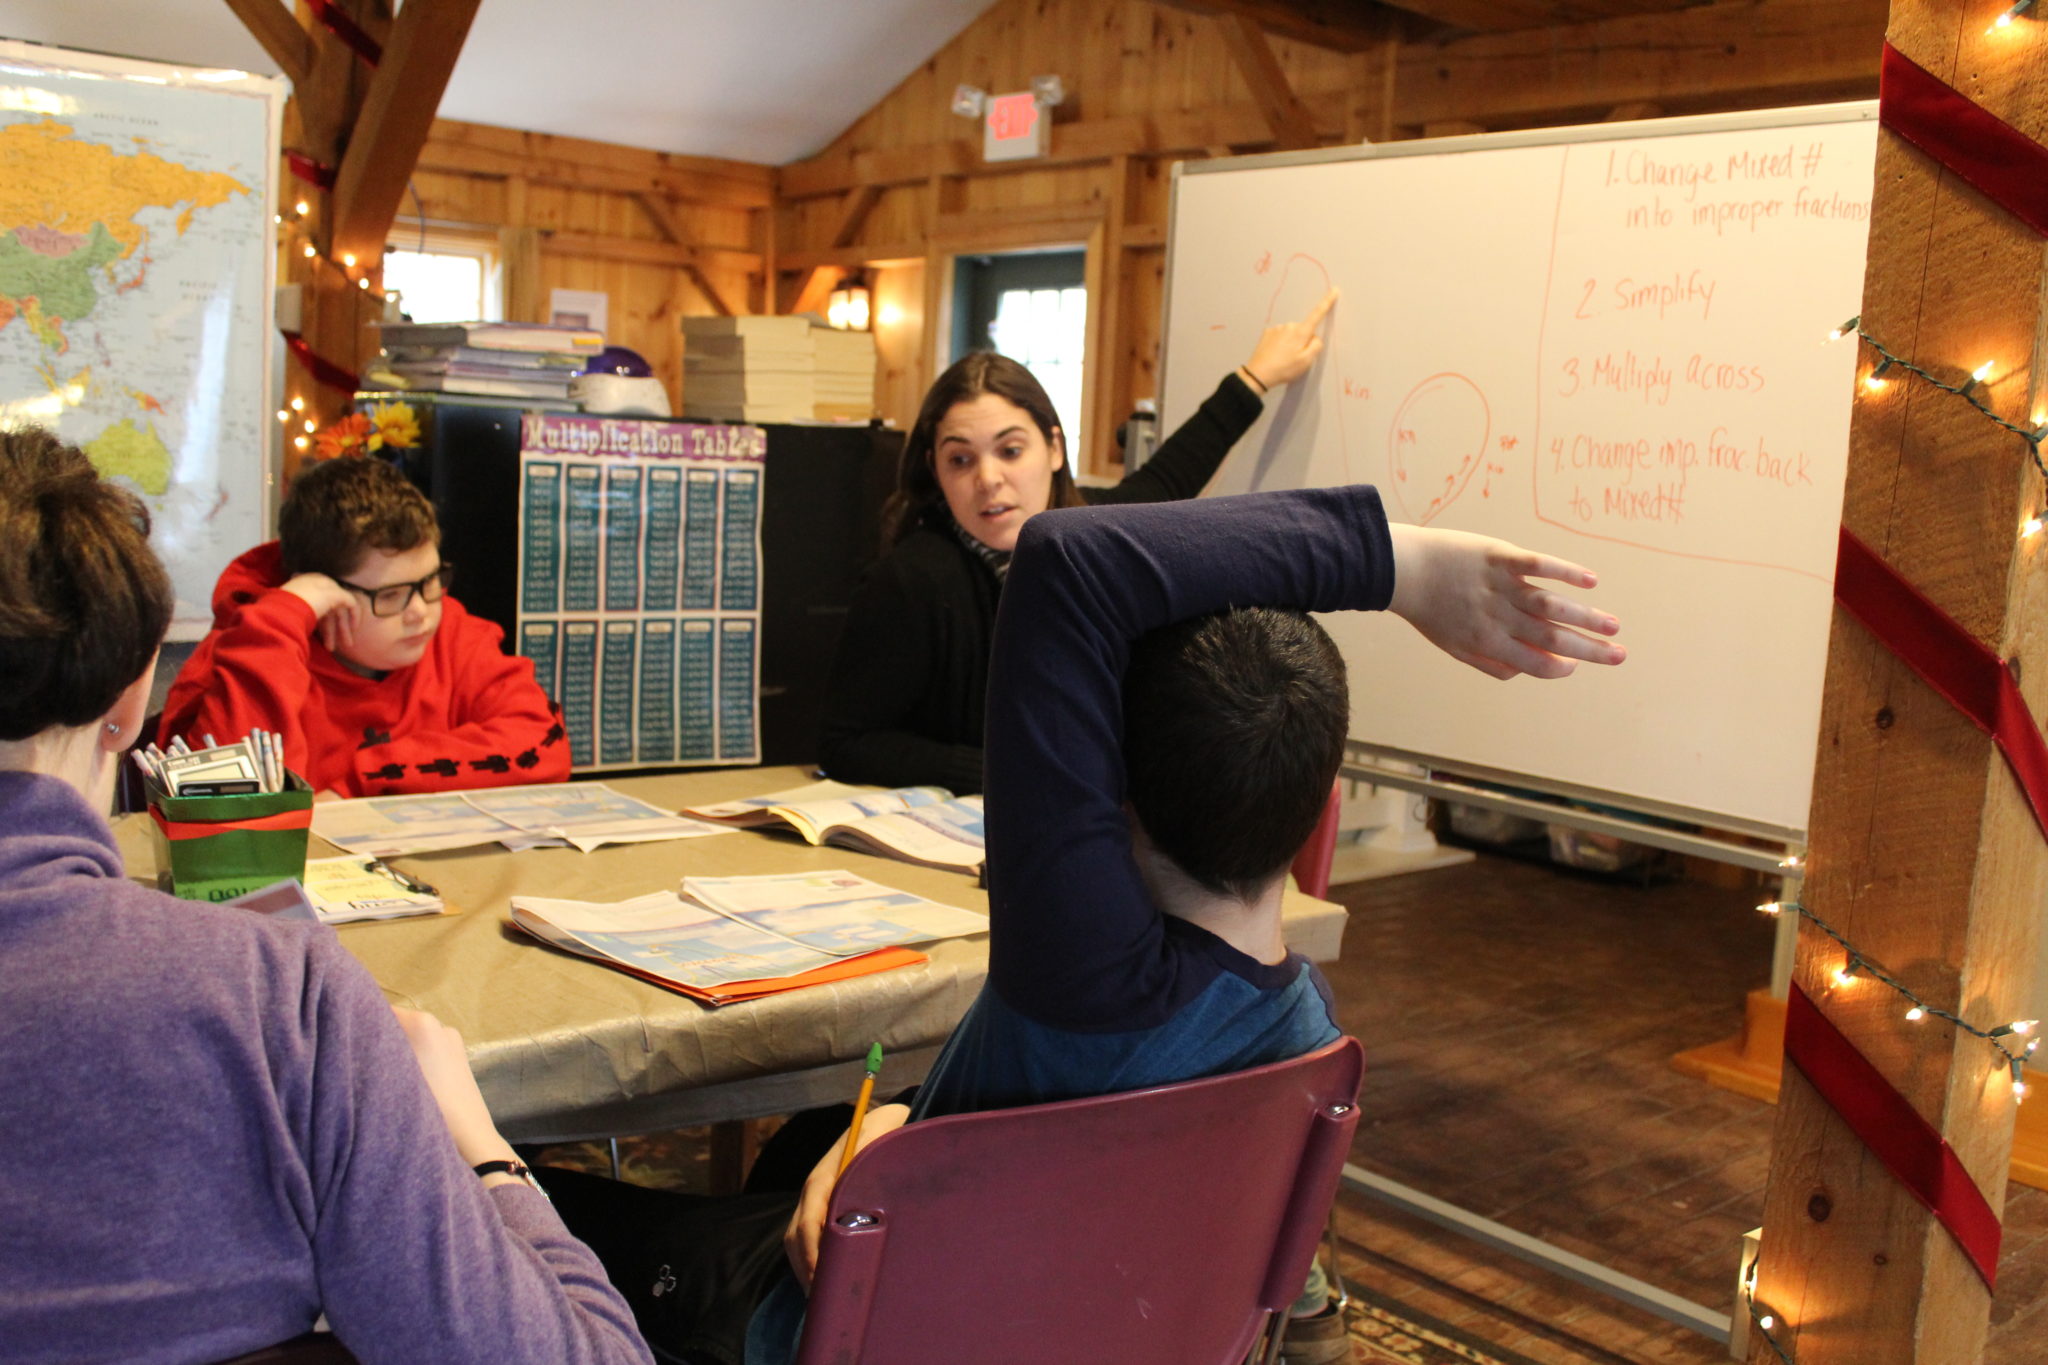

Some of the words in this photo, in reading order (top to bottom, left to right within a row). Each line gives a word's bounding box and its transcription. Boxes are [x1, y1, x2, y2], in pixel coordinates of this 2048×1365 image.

[1625, 150, 1717, 203] Change
[1727, 145, 1794, 182] Mixed
[1801, 142, 1824, 180] #
[1626, 196, 1673, 228] into
[1692, 198, 1784, 237] improper
[1793, 186, 1871, 222] fractions
[1614, 269, 1716, 320] Simplify
[1593, 350, 1673, 406] Multiply
[526, 417, 684, 455] Multiplication
[691, 426, 766, 457] Tables
[1571, 434, 1652, 486] Change
[1755, 436, 1813, 487] back
[1568, 485, 1593, 522] to
